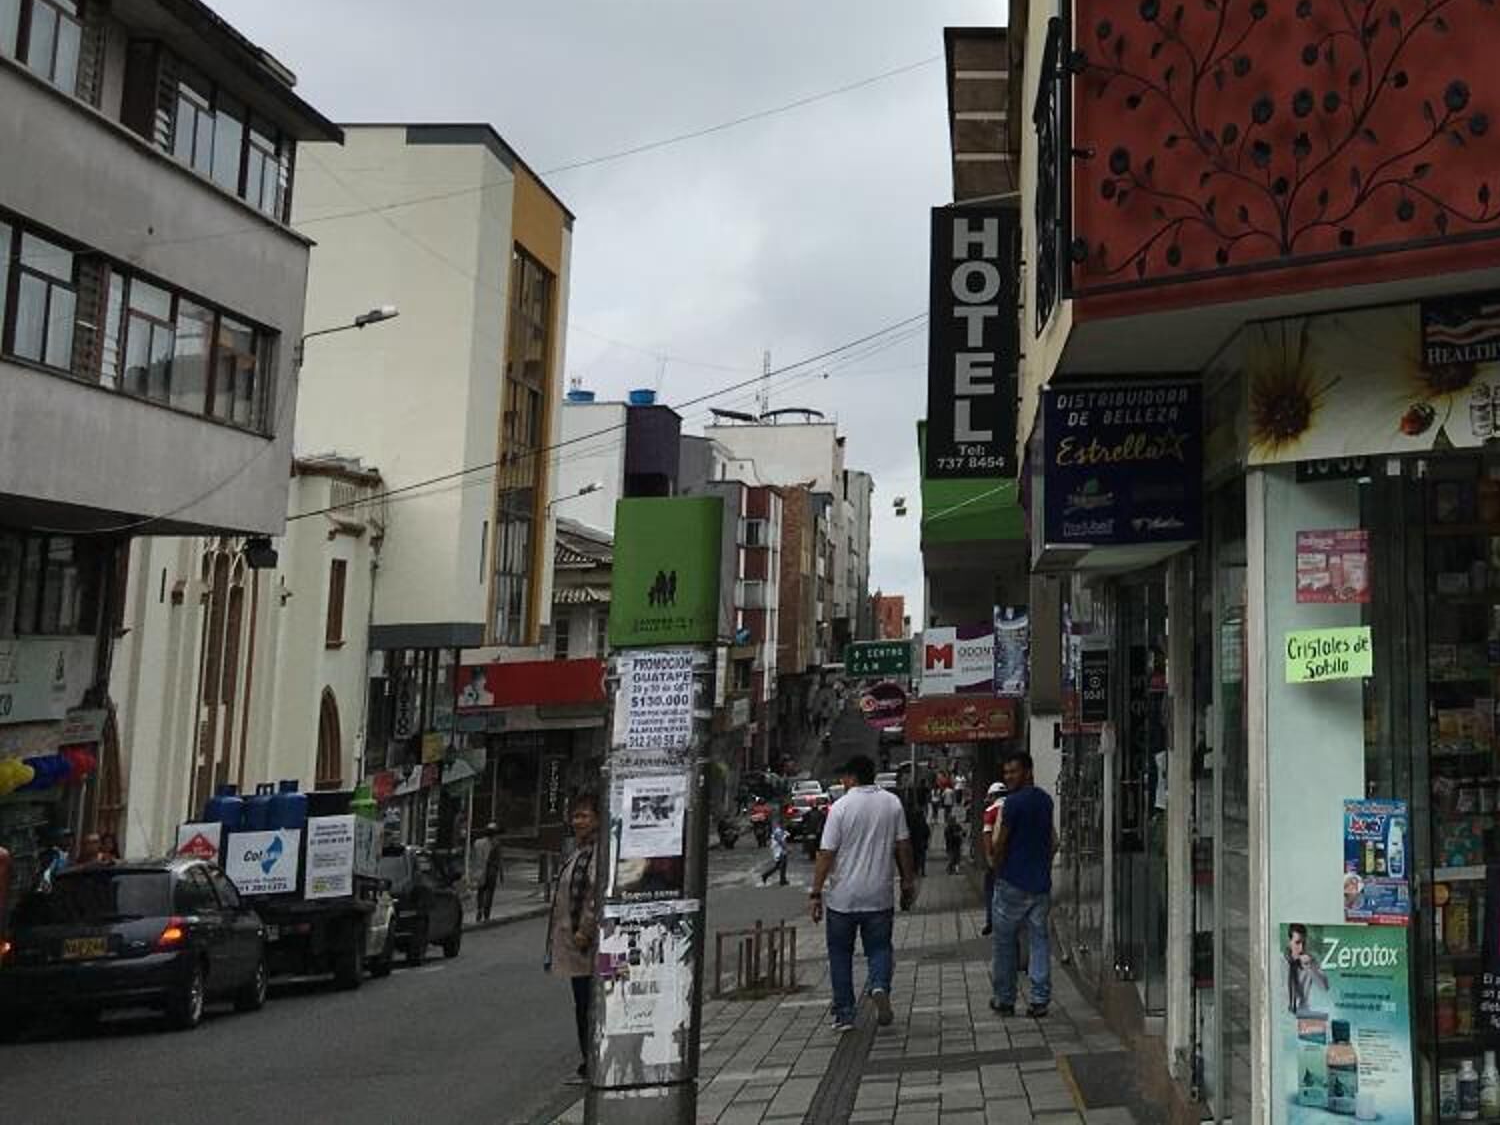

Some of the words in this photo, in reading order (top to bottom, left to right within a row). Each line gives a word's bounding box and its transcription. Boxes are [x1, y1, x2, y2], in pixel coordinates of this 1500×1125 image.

[950, 217, 1002, 443] HOTEL
[1067, 411, 1089, 426] DE
[1103, 406, 1178, 425] BELLEZA
[957, 444, 986, 456] Tel:
[937, 457, 964, 470] 737
[1320, 937, 1399, 971] Zerotox
